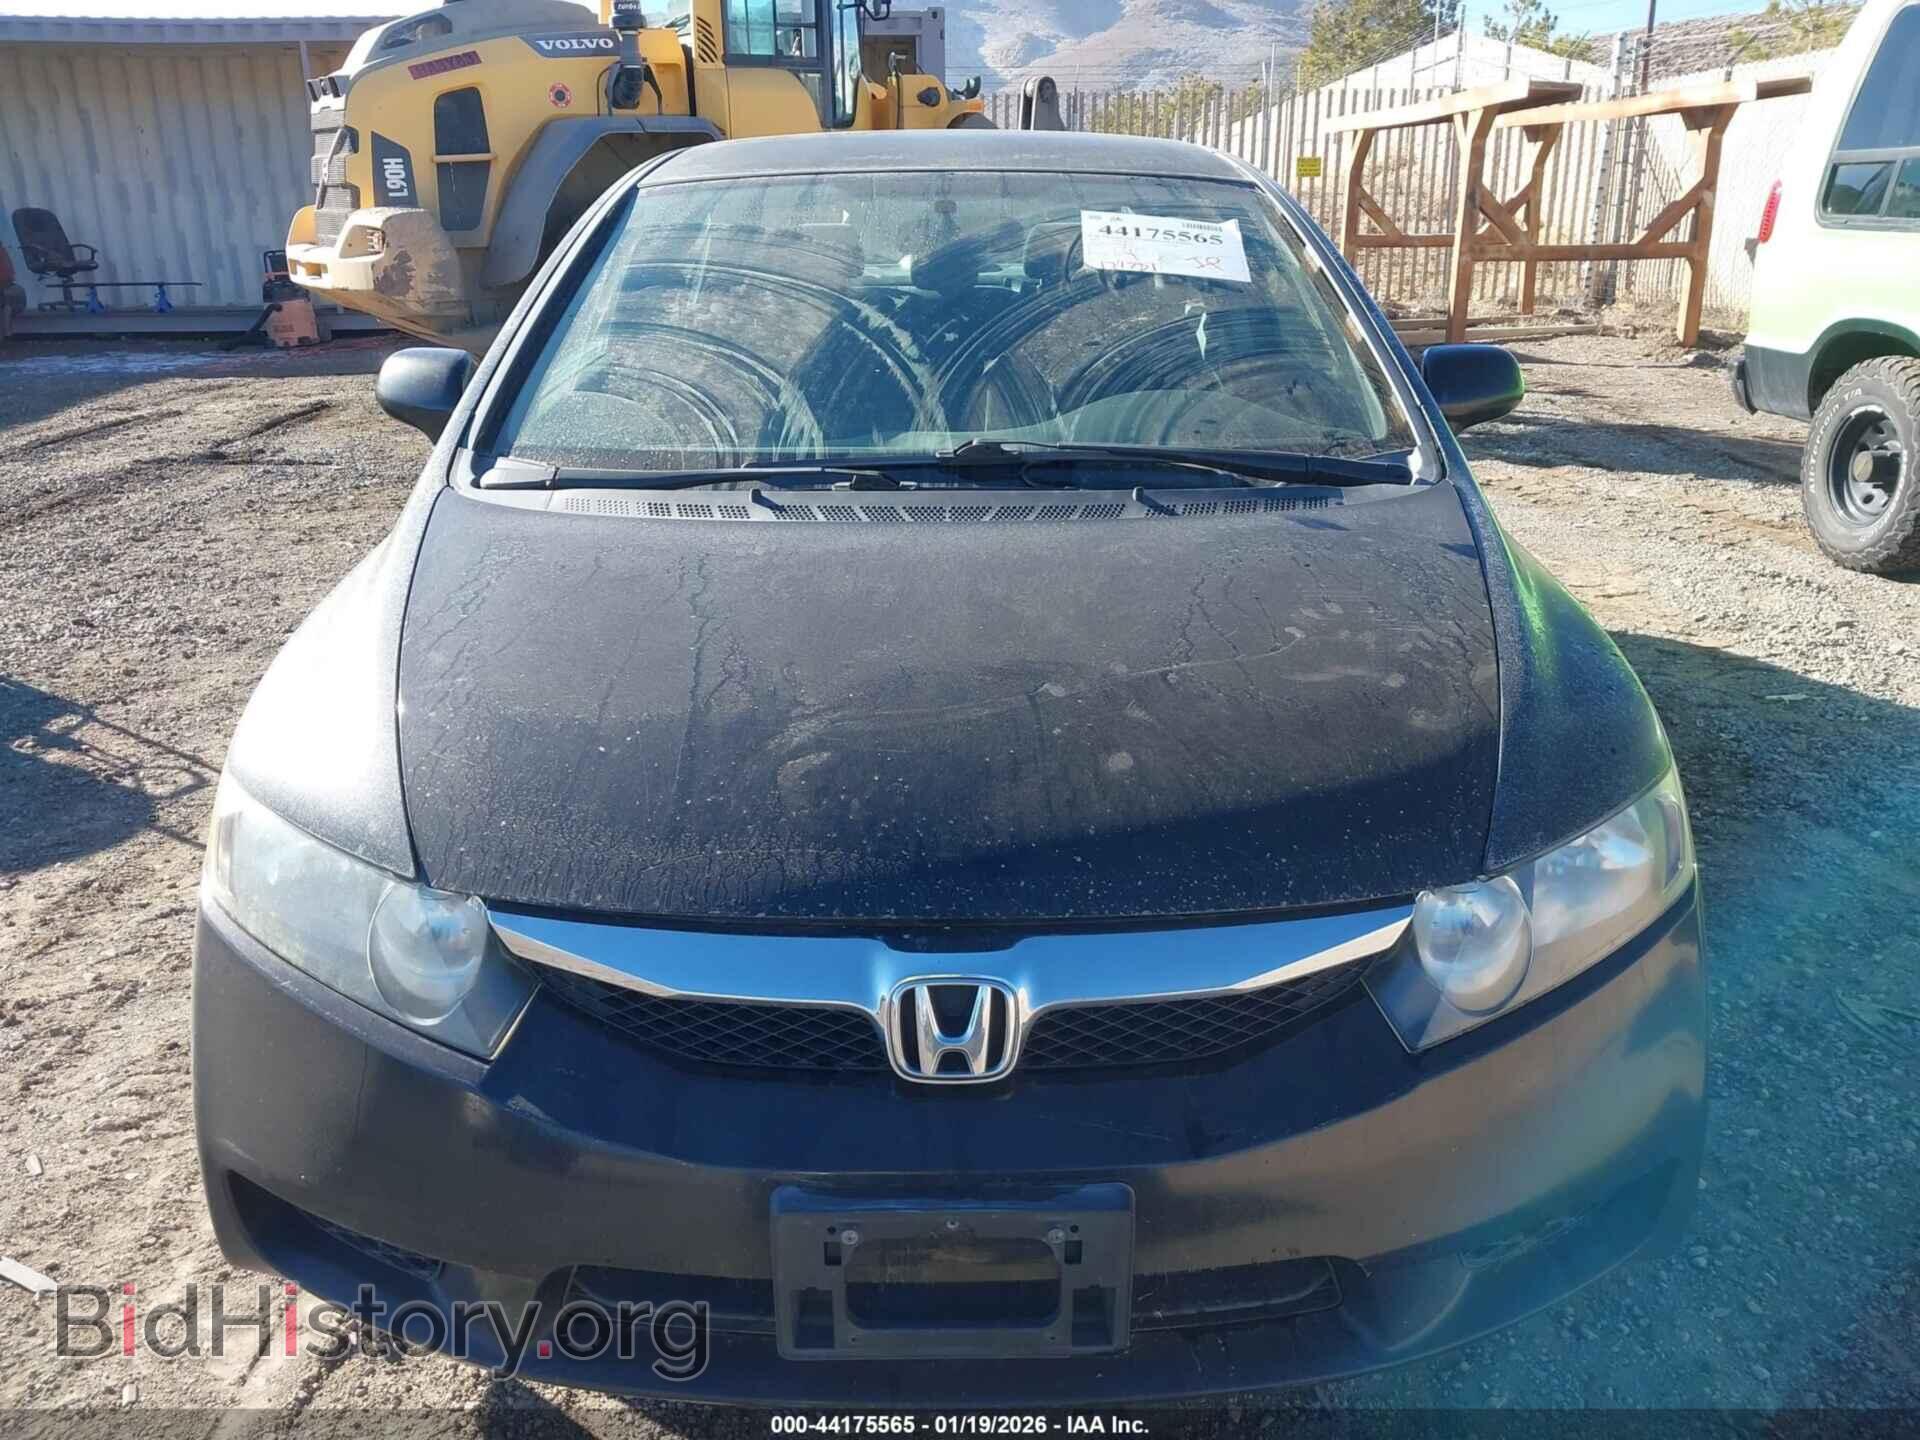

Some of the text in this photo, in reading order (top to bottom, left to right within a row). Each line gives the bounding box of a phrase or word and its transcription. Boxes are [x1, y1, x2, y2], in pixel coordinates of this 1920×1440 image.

[536, 38, 614, 50] VOLVO
[382, 158, 409, 198] L90H
[1099, 224, 1224, 246] 44175565
[1843, 387, 1863, 402] T/A
